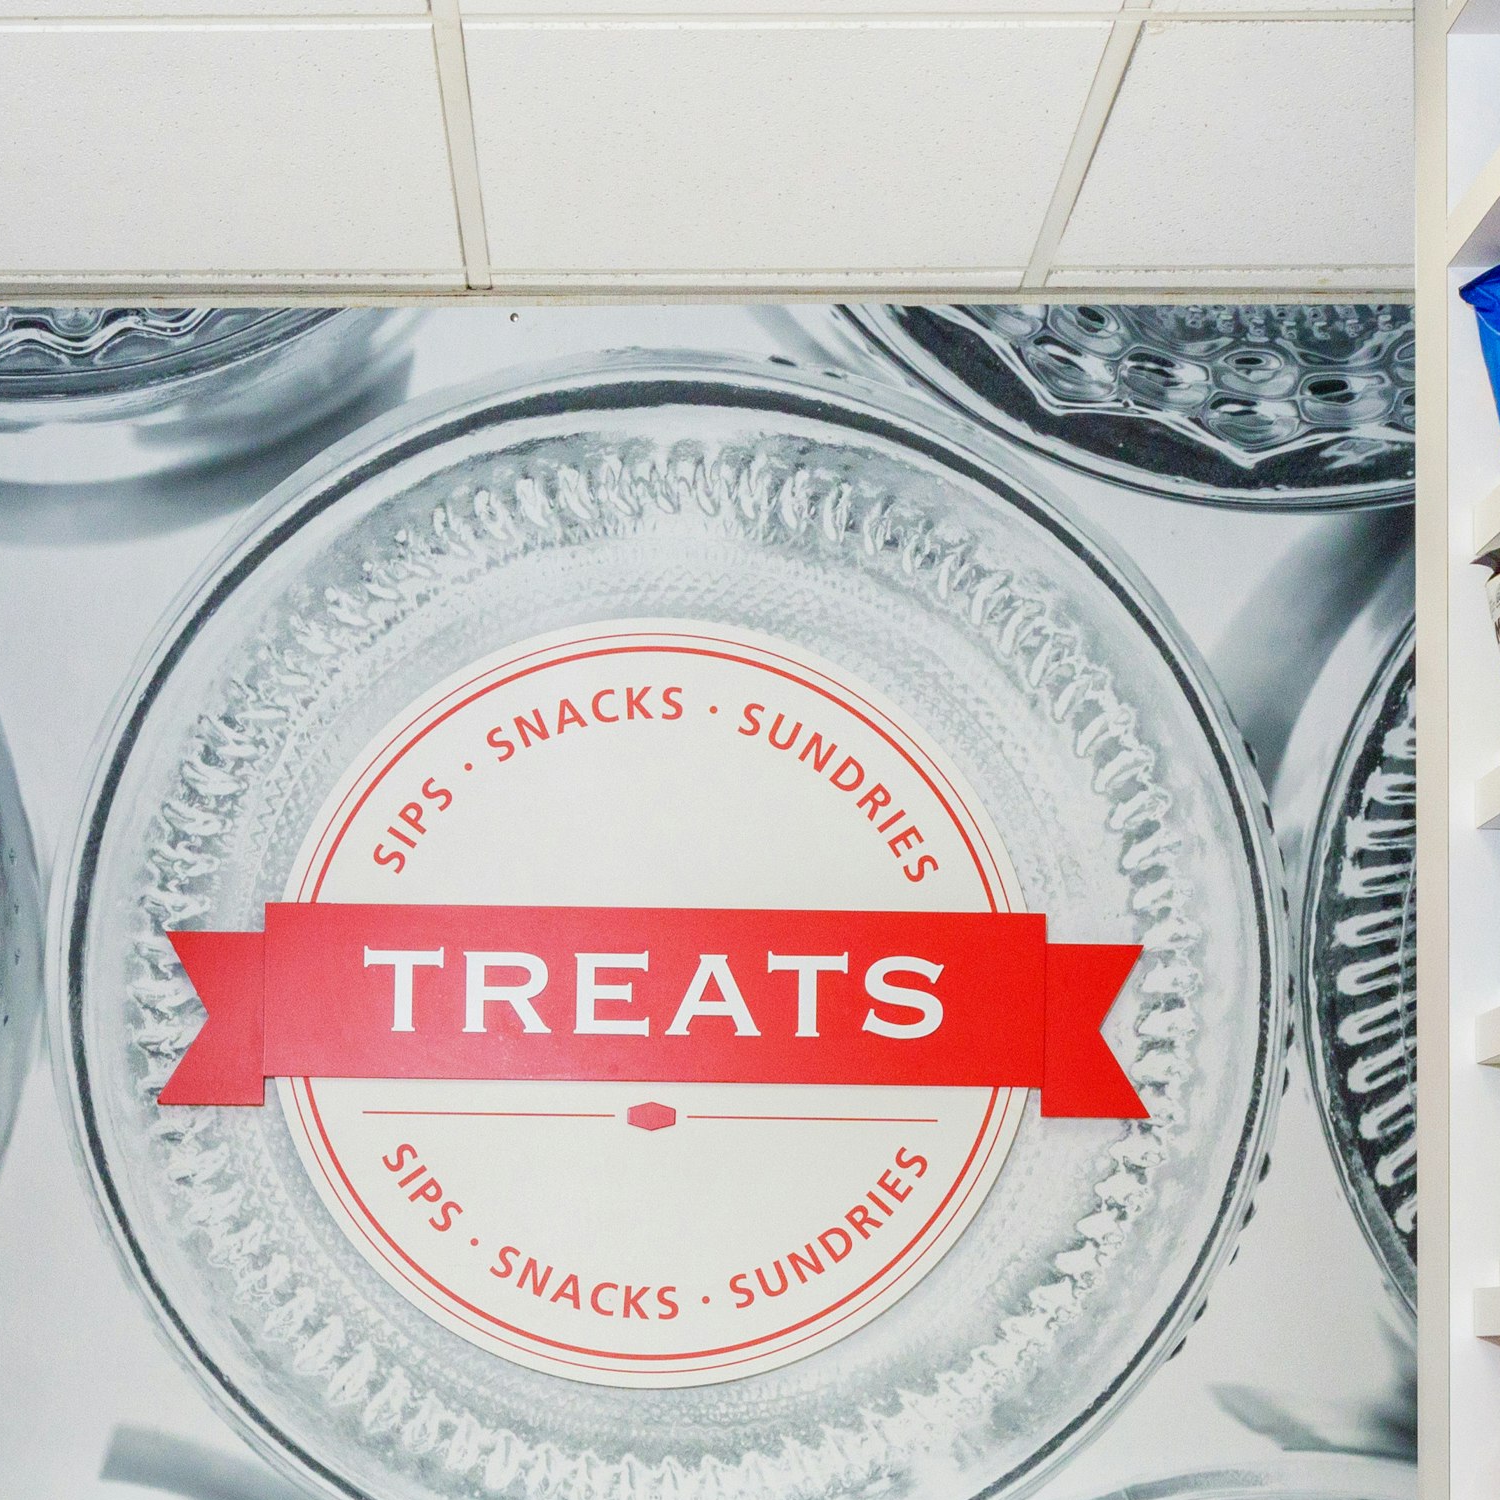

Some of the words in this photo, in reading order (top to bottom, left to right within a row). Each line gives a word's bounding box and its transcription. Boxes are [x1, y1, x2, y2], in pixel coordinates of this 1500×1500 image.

[373, 776, 454, 873] SIPS
[485, 684, 686, 762] SNACKS
[737, 703, 938, 882] SUNDRIES
[362, 945, 944, 1040] TREATS
[383, 1143, 463, 1234] SIPS
[491, 1246, 680, 1320] SNACKS
[729, 1147, 927, 1310] SUNDRIES
